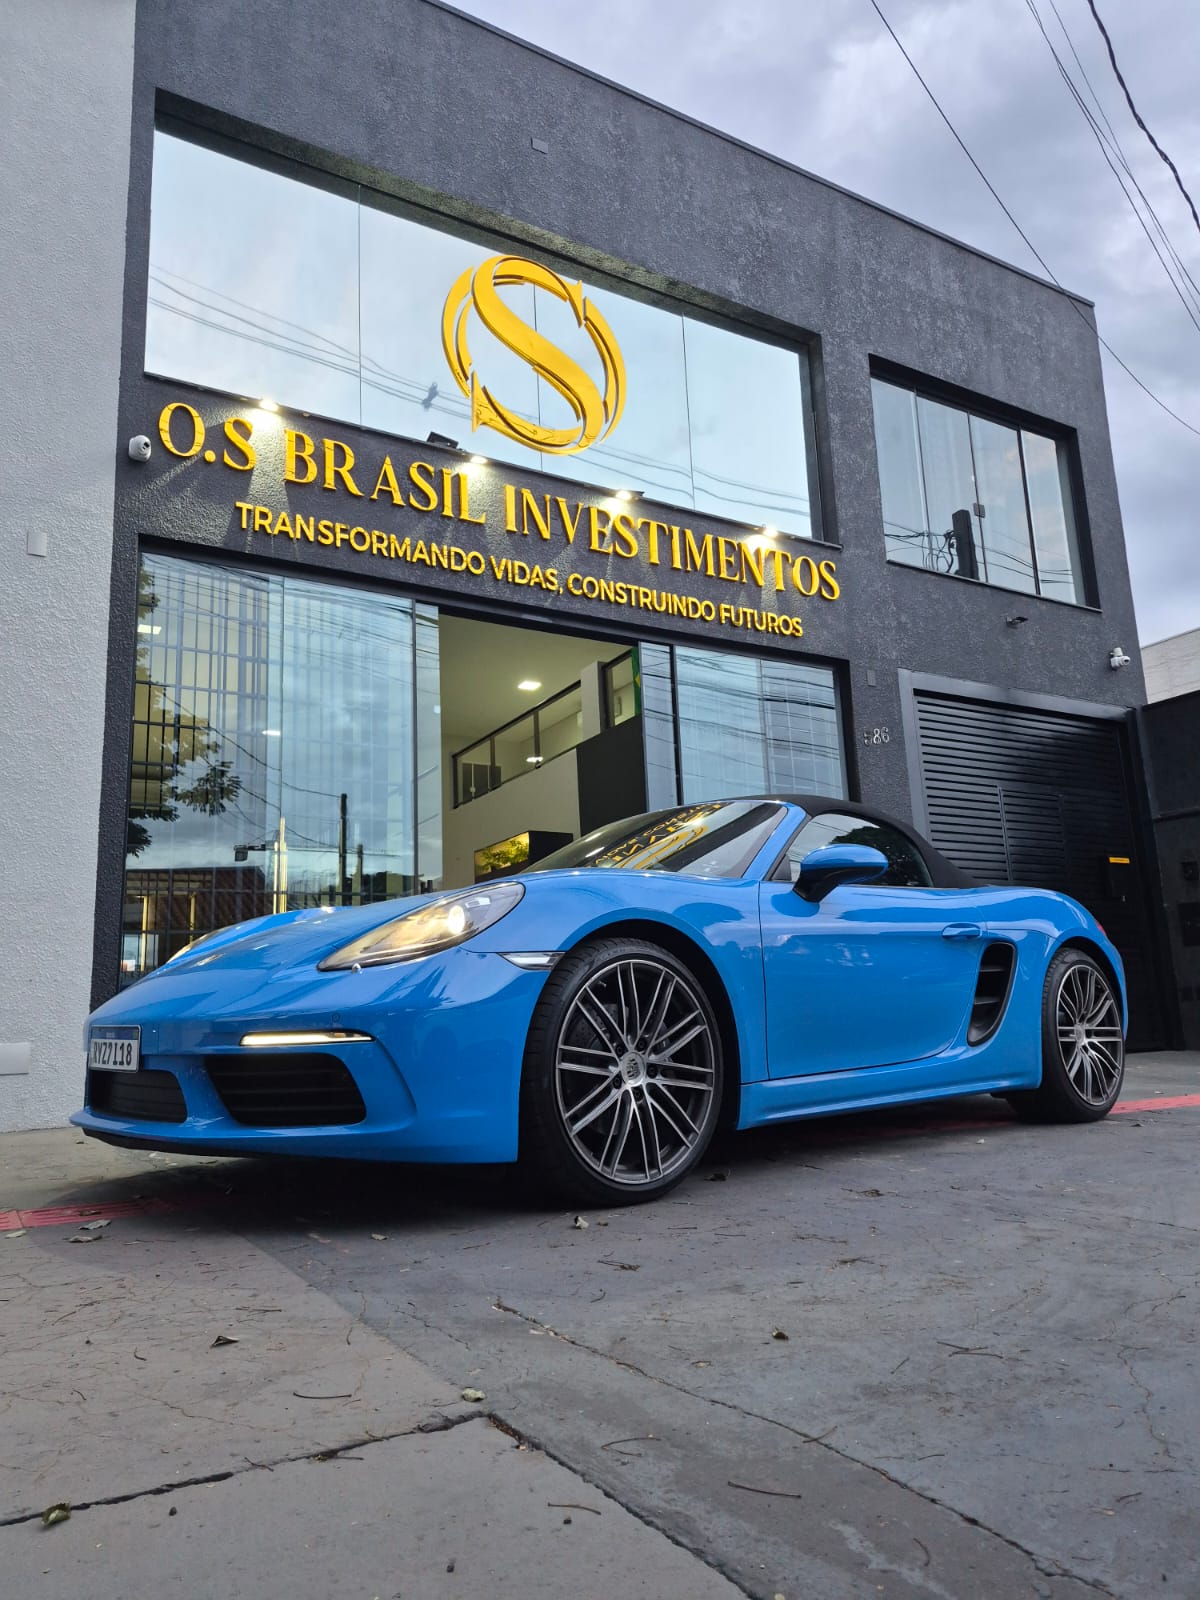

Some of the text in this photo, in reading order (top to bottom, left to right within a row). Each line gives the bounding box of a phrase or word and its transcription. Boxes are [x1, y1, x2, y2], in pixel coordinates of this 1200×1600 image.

[158, 402, 841, 600] O.S BRASIL INVESTIMENTOS
[235, 501, 804, 637] TRANSFORMANDO VIDAS, CONSTRUINDO FUTUROS
